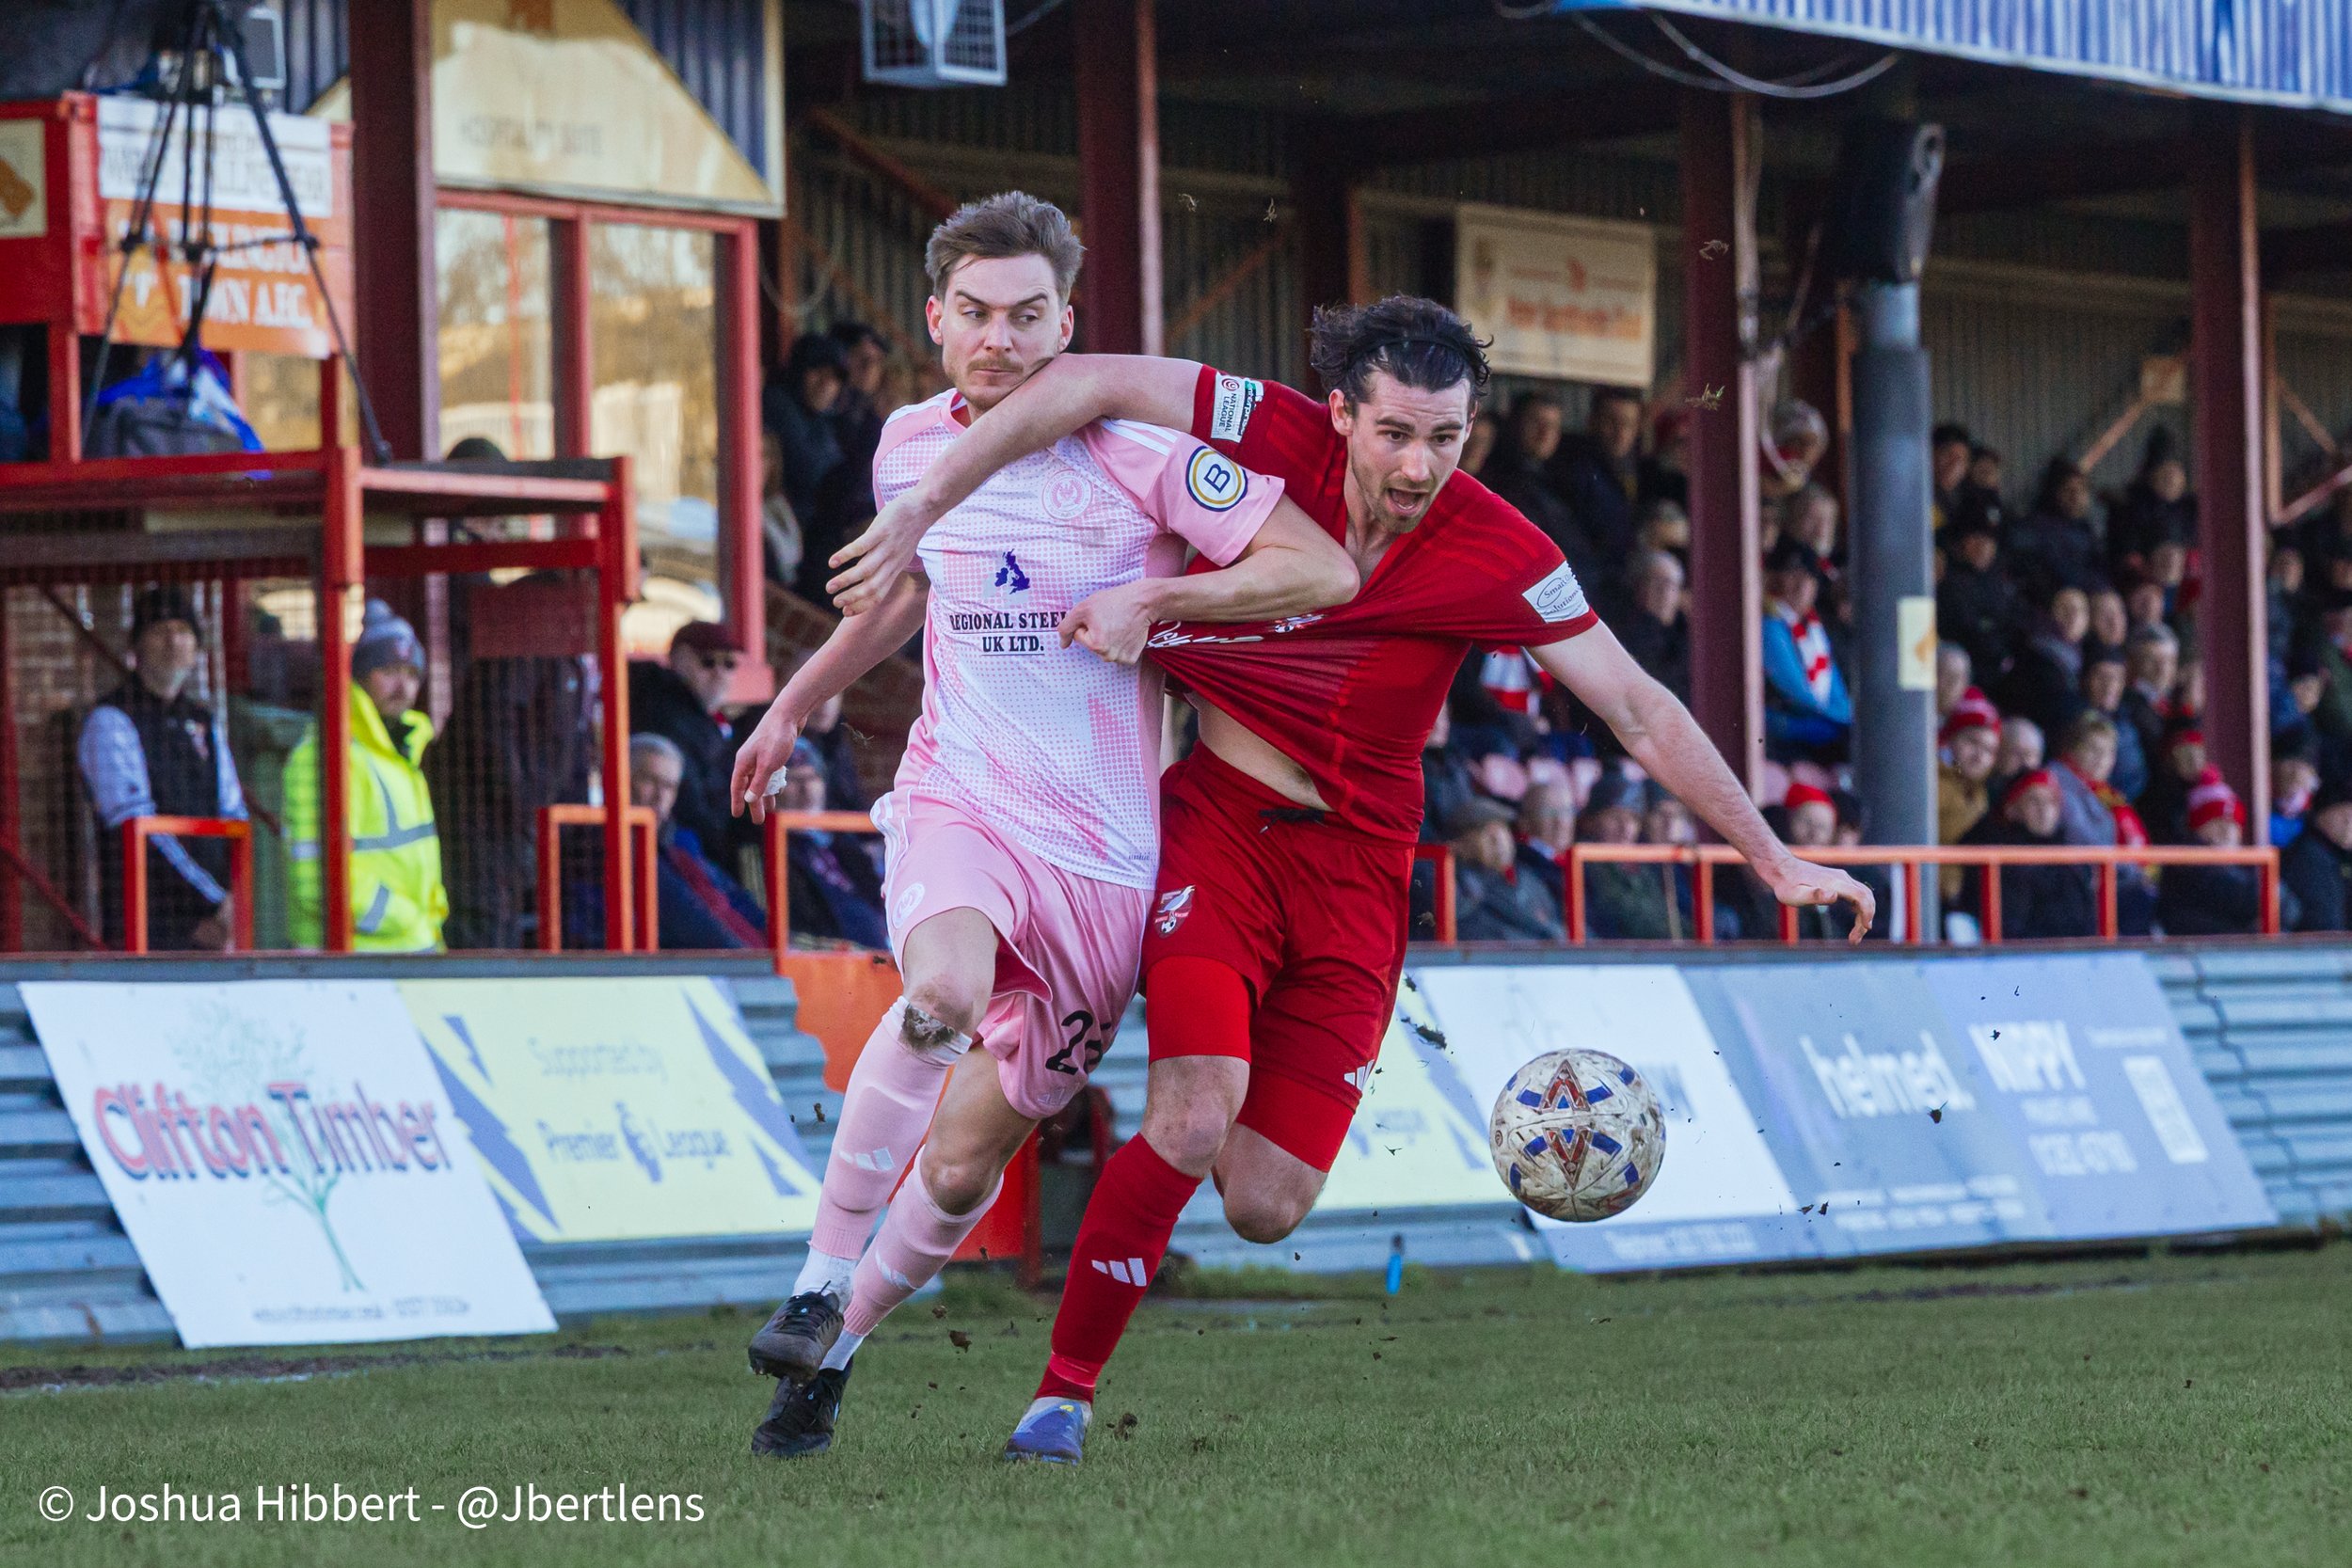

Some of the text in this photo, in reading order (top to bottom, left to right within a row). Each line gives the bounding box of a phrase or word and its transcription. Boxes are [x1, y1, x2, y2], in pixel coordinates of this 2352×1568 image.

[1219, 396, 1229, 427] LEAGUE
[1225, 393, 1236, 432] NATIONAL
[1203, 464, 1231, 494] B
[949, 612, 1014, 631] REGIONAL
[982, 635, 1044, 653] UK LTD.
[94, 1081, 453, 1180] Clifton Timber
